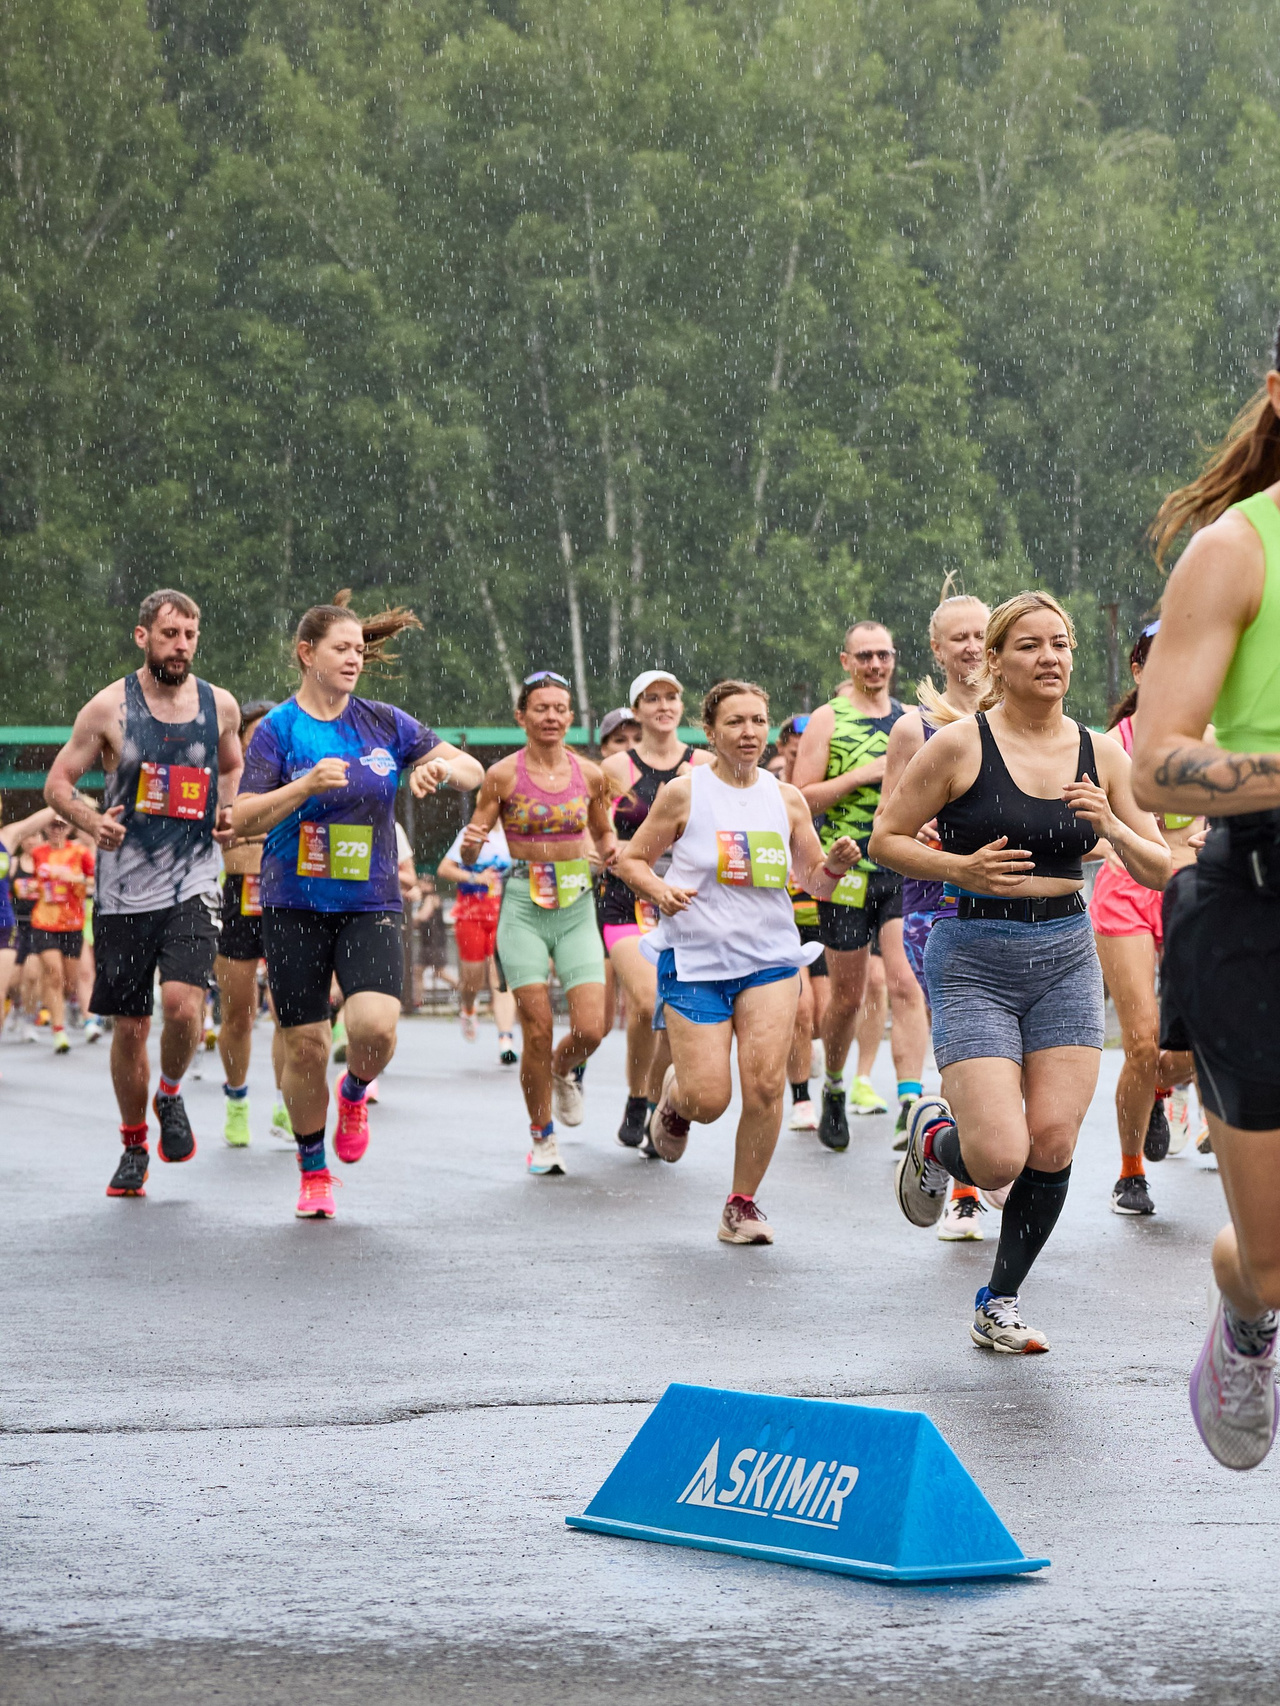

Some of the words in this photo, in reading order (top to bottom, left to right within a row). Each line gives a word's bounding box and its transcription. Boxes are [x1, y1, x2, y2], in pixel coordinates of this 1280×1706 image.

[181, 782, 200, 800] 13
[335, 841, 368, 858] 279
[755, 846, 786, 866] 295
